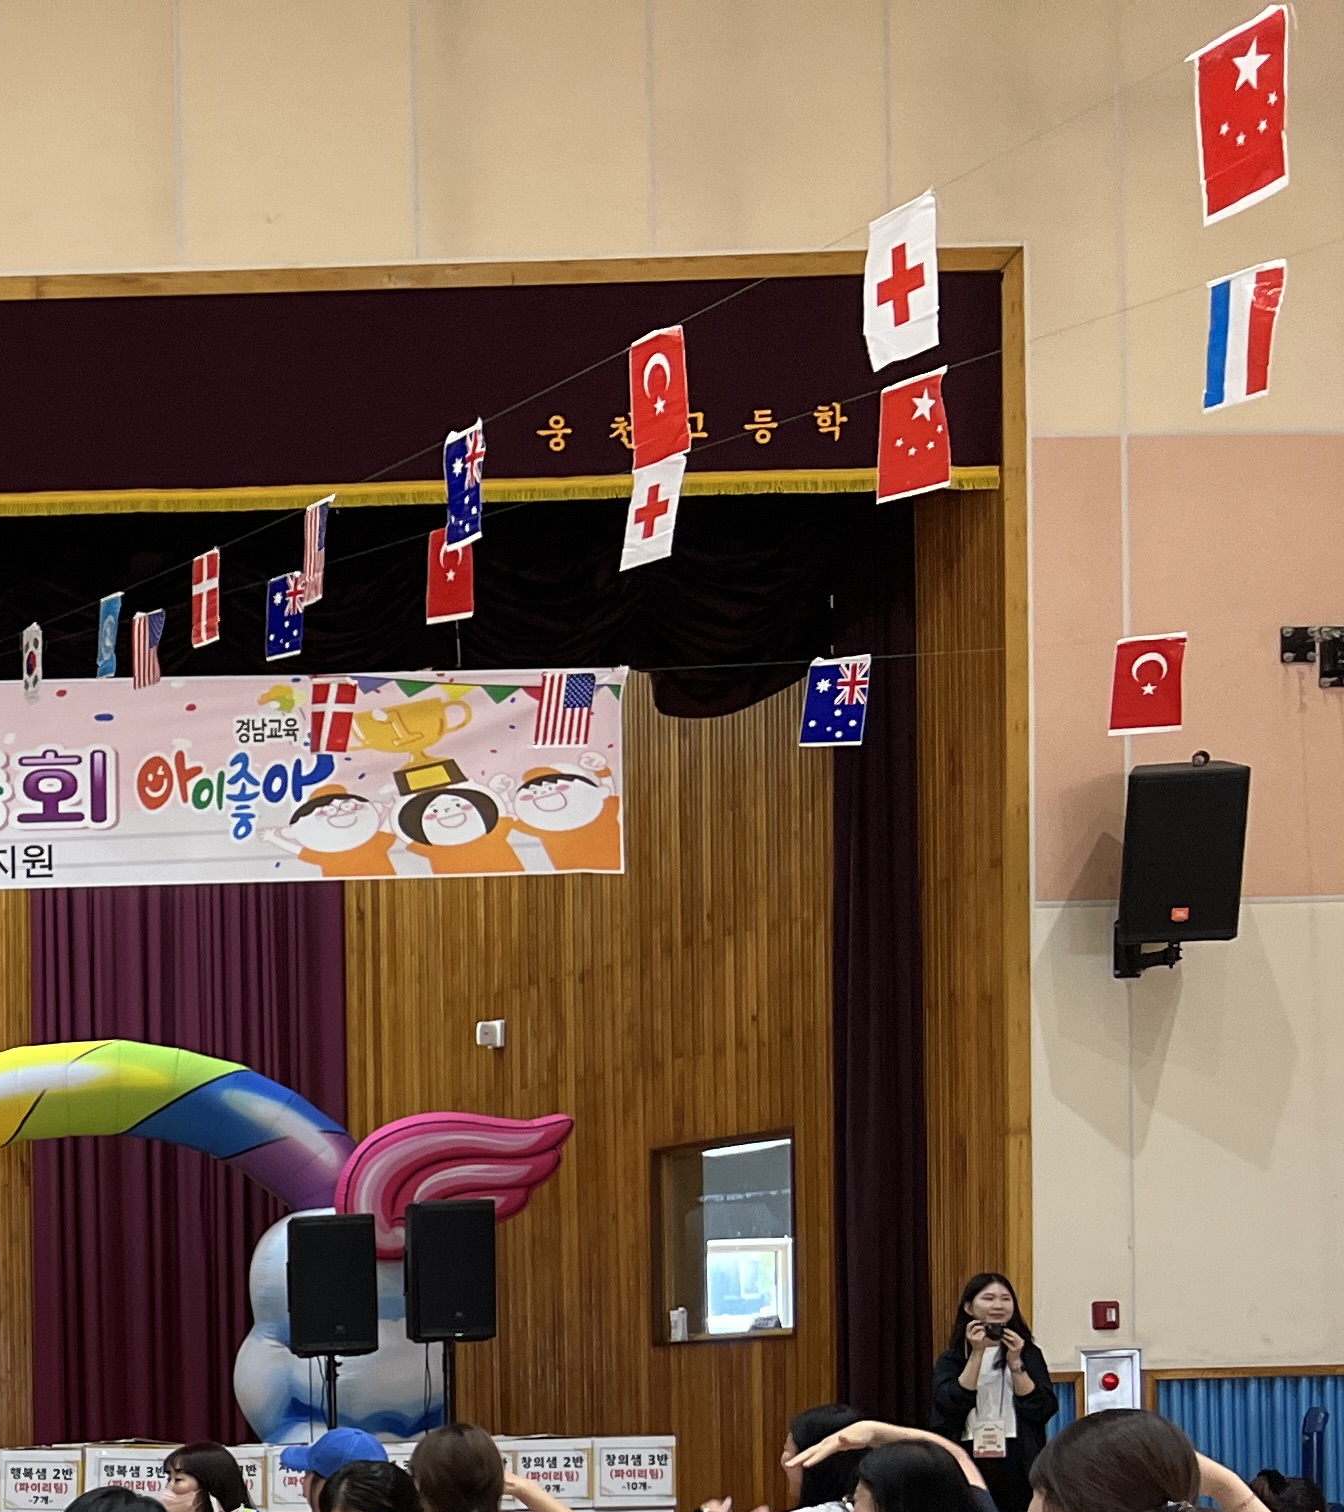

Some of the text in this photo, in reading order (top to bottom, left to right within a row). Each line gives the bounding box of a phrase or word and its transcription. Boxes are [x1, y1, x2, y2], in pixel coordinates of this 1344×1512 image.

[234, 716, 300, 744] 경남교육
[521, 1456, 584, 1469] 창의샘 2반
[605, 1453, 669, 1467] 창의샘 3반
[10, 1467, 74, 1481] 행복샘 2반
[103, 1464, 141, 1478] 행복샘
